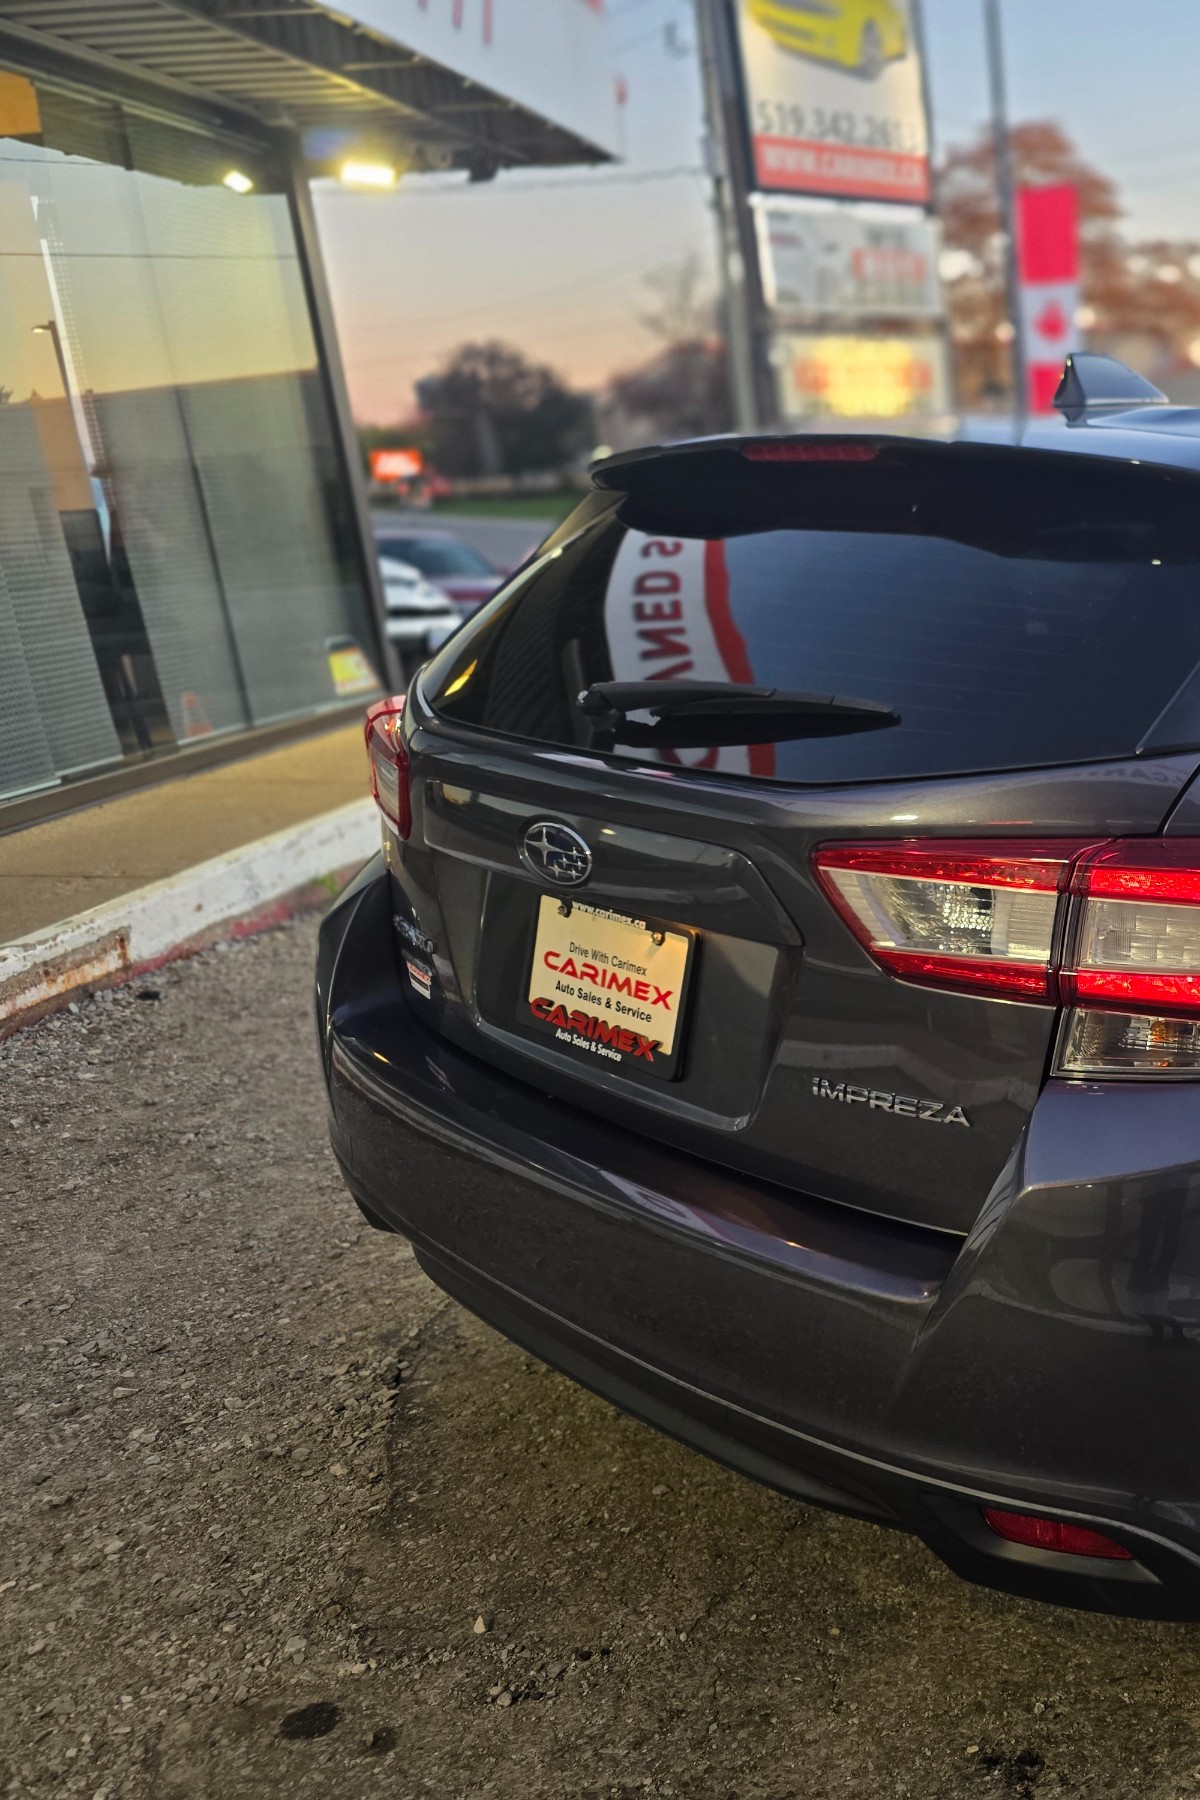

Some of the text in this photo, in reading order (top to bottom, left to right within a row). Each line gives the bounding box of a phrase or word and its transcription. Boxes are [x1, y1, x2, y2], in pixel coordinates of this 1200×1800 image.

[572, 901, 646, 930] www.carimex.ca
[543, 951, 674, 1010] CARIMEX
[569, 942, 647, 976] Drive With Carimex
[555, 980, 652, 1023] Auto Sales & Service
[530, 997, 655, 1062] CARIMEX
[555, 1028, 622, 1062] Auto Sales & Service
[812, 1077, 971, 1127] IMPREZA
